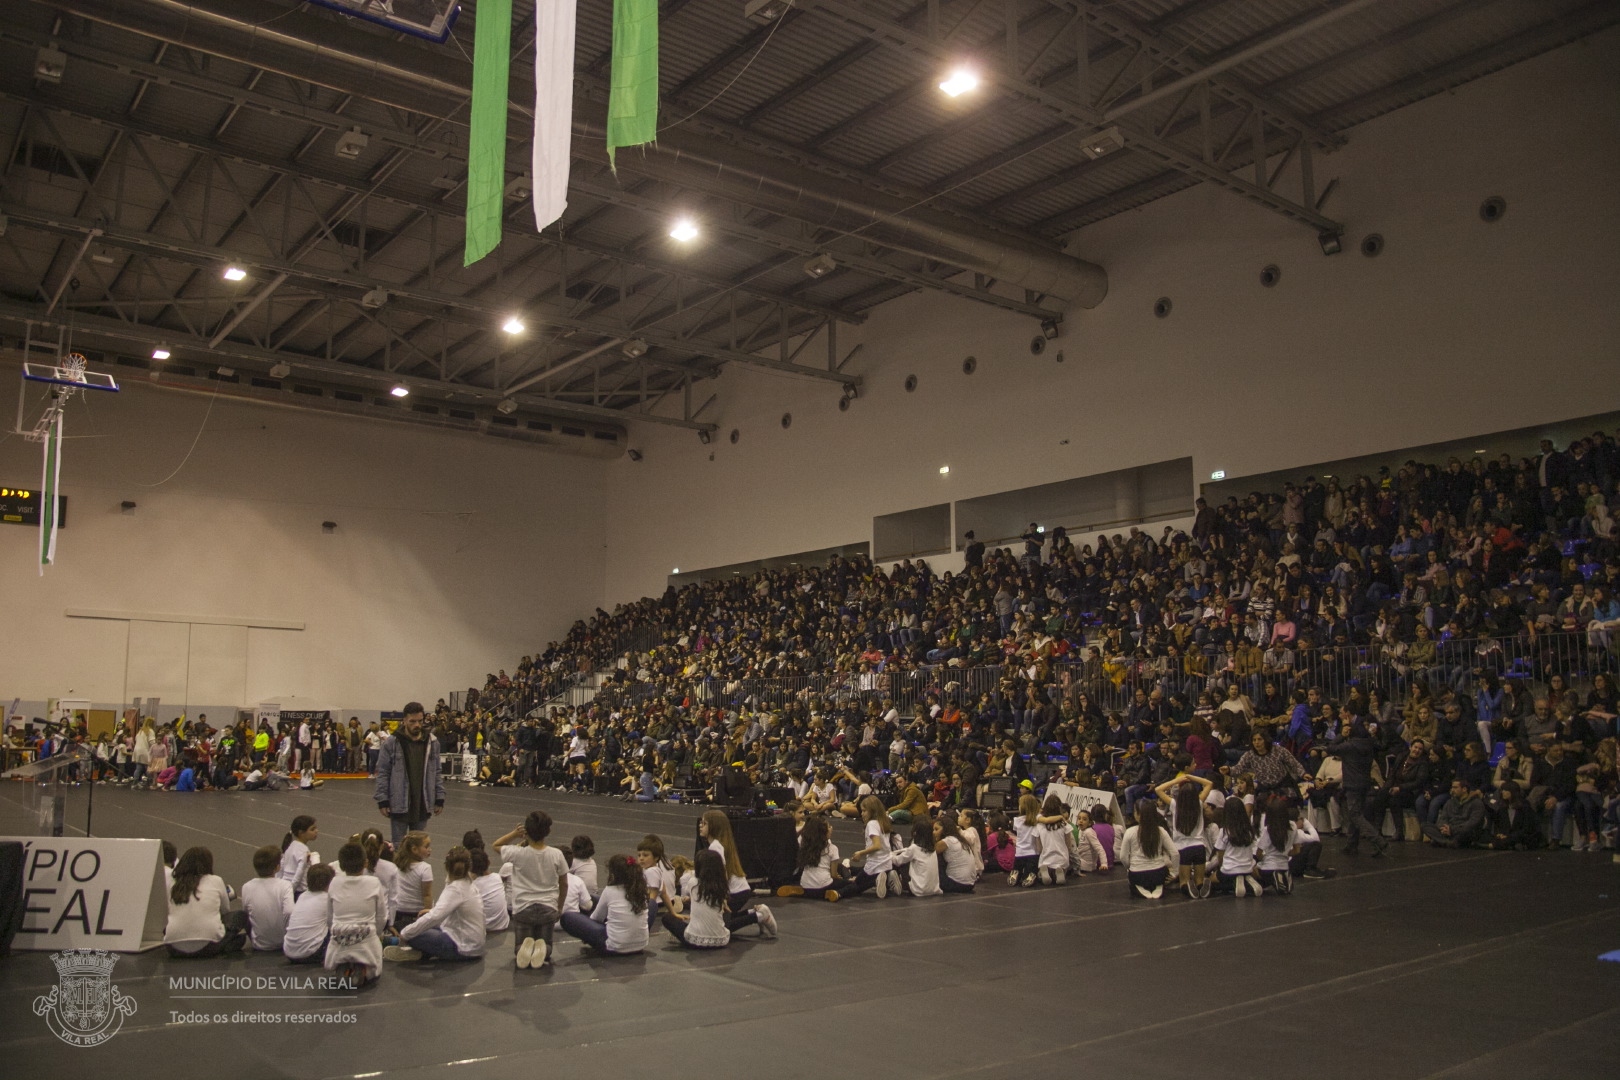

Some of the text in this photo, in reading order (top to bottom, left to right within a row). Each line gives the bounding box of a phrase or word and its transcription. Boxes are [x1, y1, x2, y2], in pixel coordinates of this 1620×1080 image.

[305, 712, 324, 720] CLUB
[24, 841, 101, 882] ÍPIO
[16, 888, 124, 935] EAL
